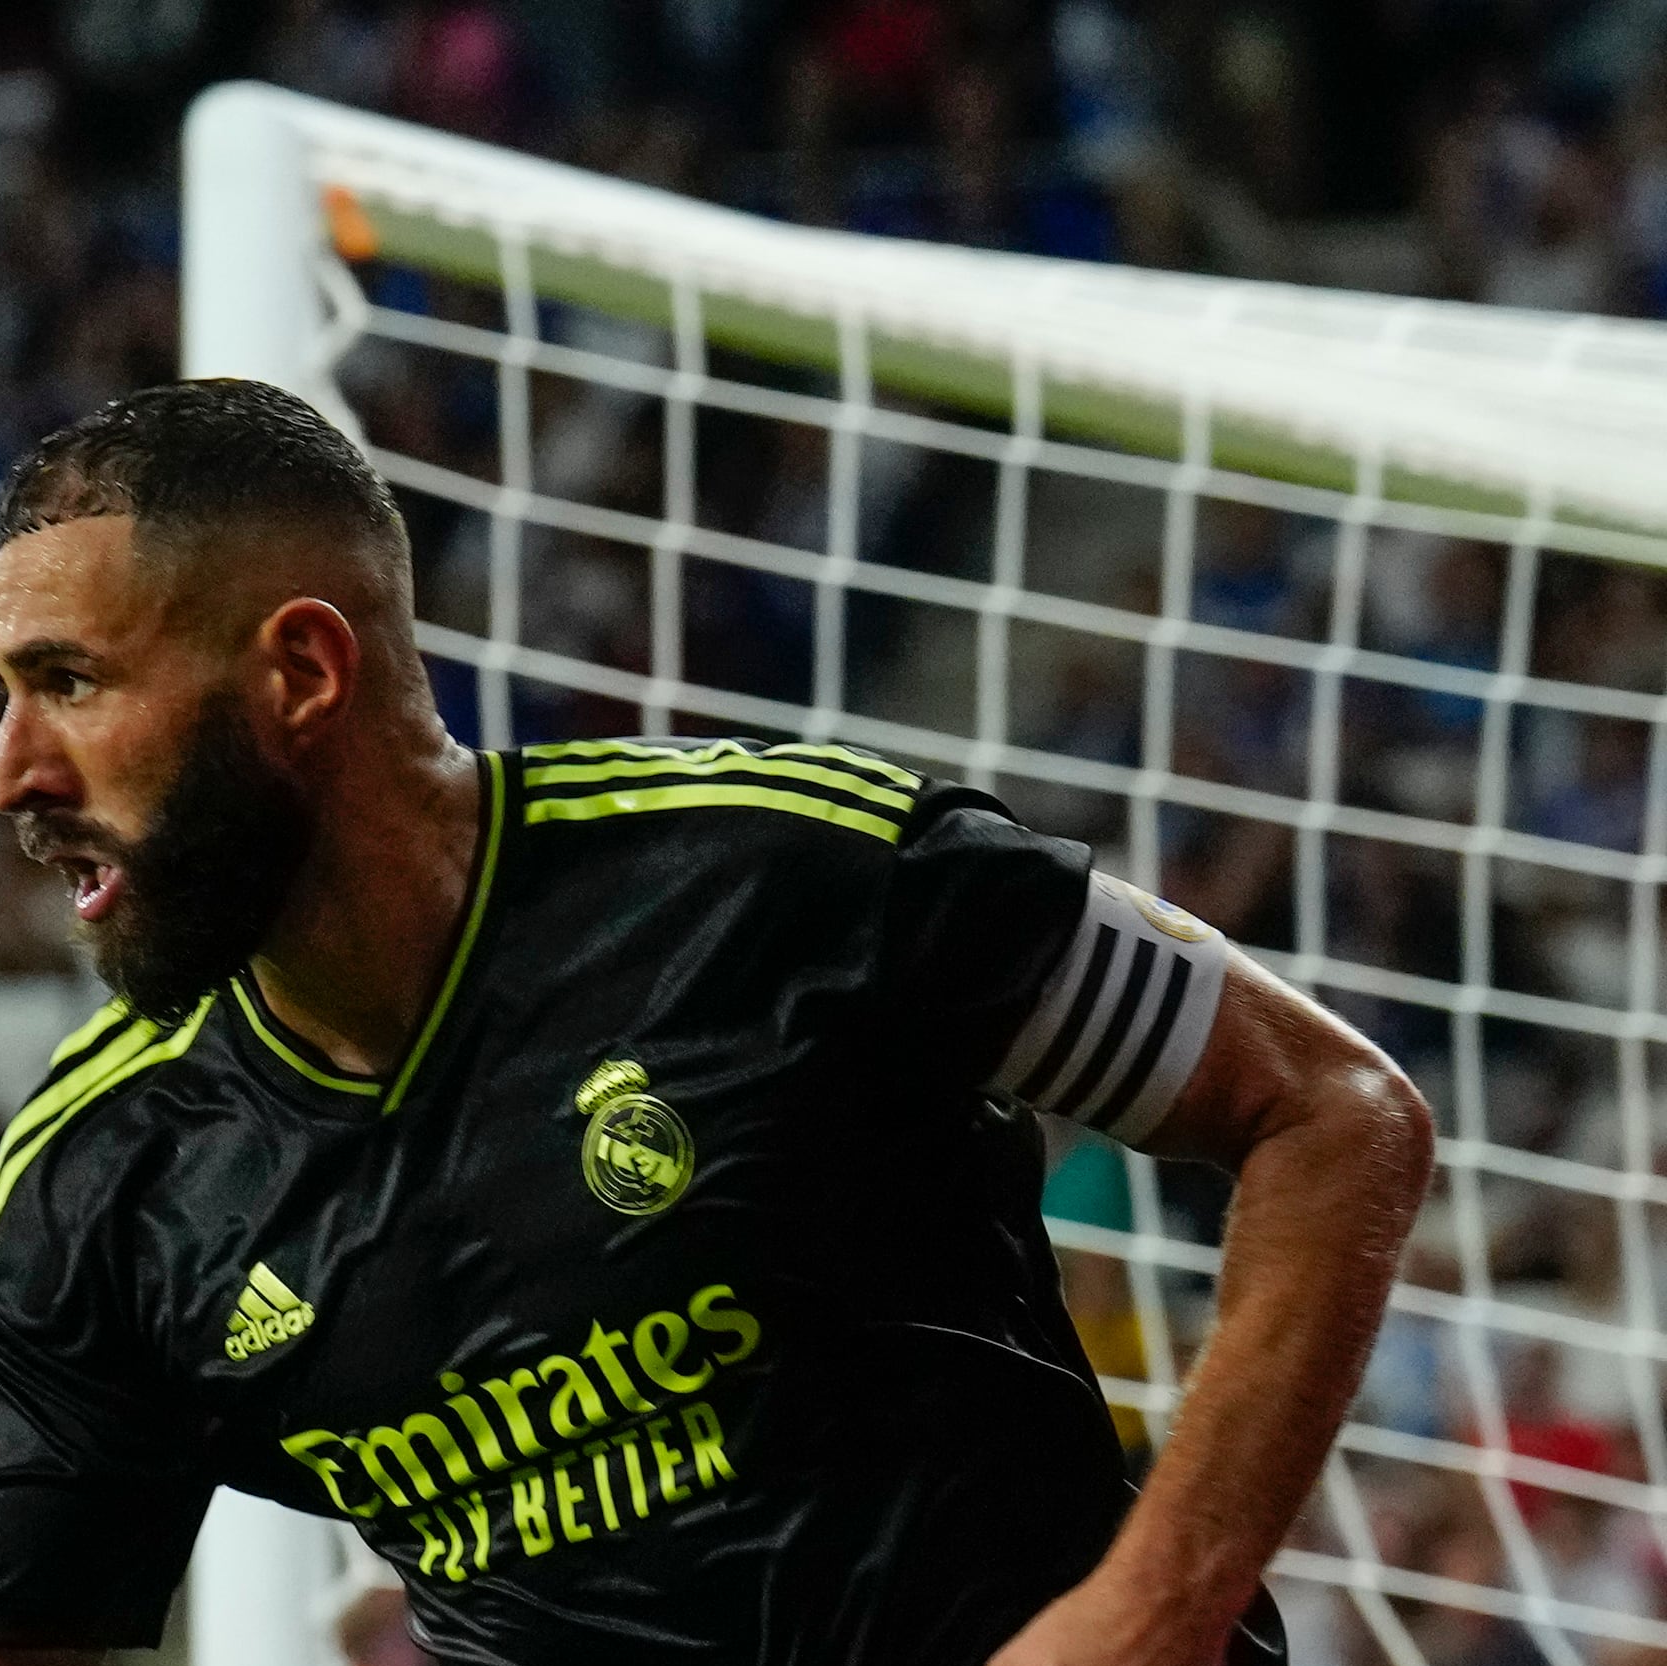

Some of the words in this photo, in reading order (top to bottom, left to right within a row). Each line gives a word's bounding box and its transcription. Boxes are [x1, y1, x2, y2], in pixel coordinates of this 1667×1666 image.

[224, 1301, 316, 1362] adidas
[280, 1284, 761, 1518] Emirates
[511, 1401, 738, 1557] BETTER
